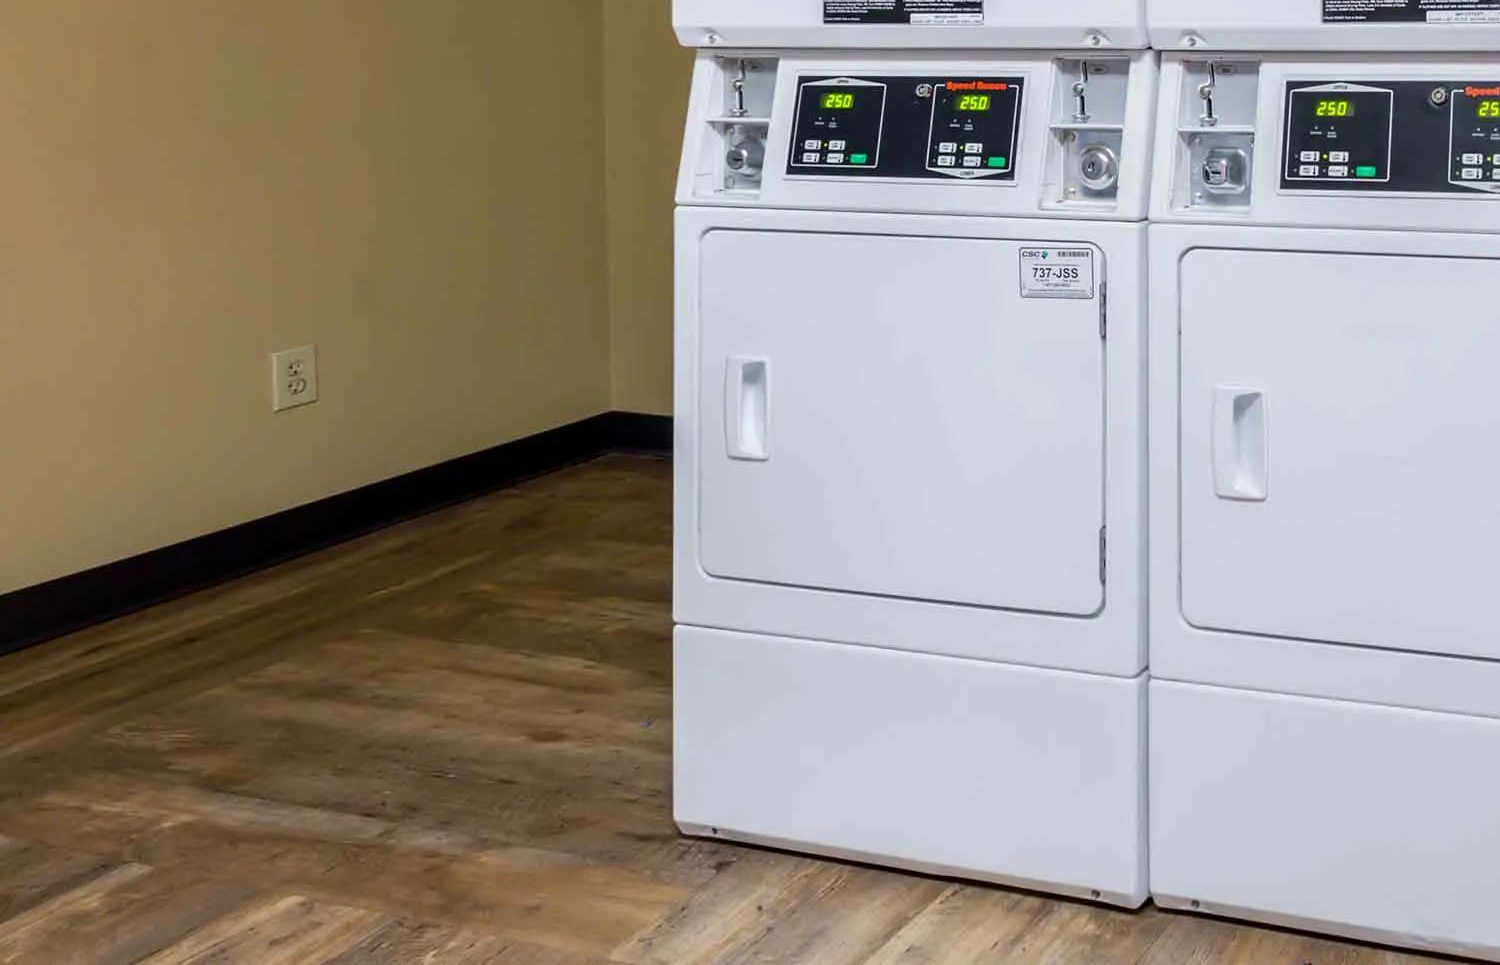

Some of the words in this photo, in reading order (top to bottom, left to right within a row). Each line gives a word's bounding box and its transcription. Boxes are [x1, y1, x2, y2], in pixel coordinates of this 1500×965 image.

[946, 81, 976, 91] Speed
[977, 81, 1008, 91] Queen
[1465, 86, 1500, 97] Speed
[1032, 267, 1079, 279] 737-JSS
